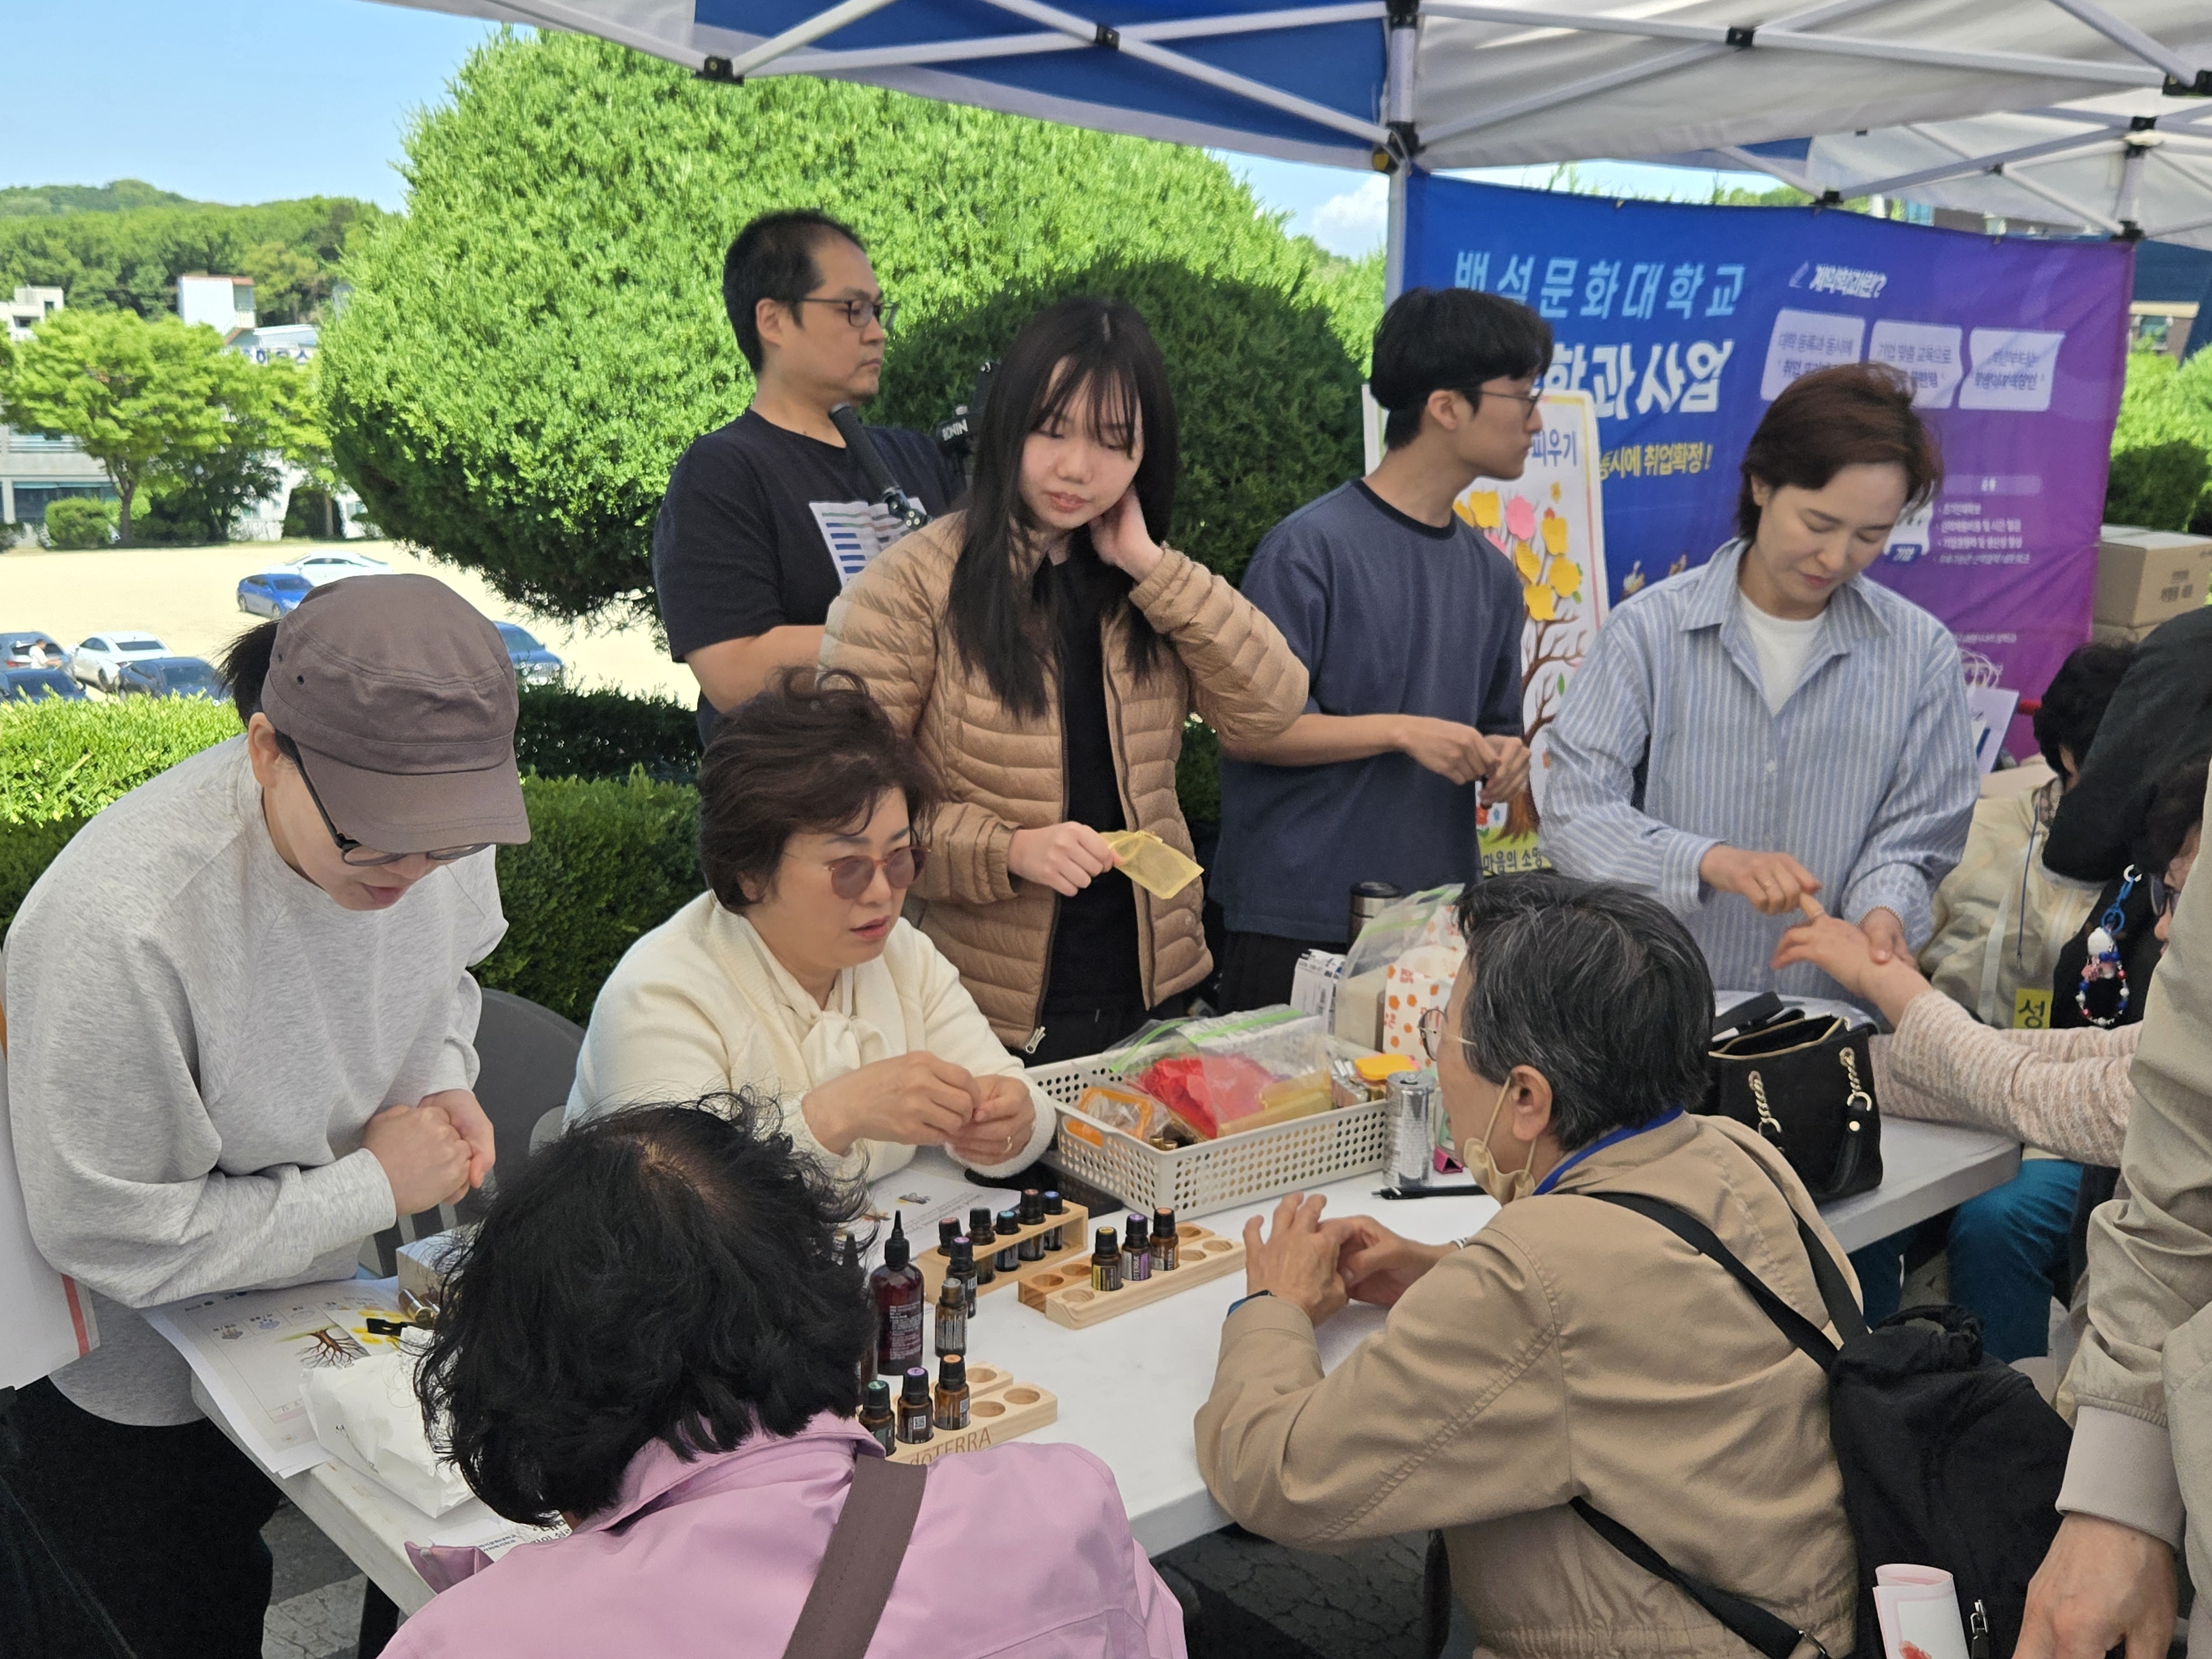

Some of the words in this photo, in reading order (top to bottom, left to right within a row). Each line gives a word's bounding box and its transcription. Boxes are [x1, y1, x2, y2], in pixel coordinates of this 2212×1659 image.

[1535, 338, 1734, 420] 학과사업
[1644, 441, 1713, 476] 취업확정!
[1483, 849, 1517, 874] 마음의
[2018, 999, 2045, 1029] 성
